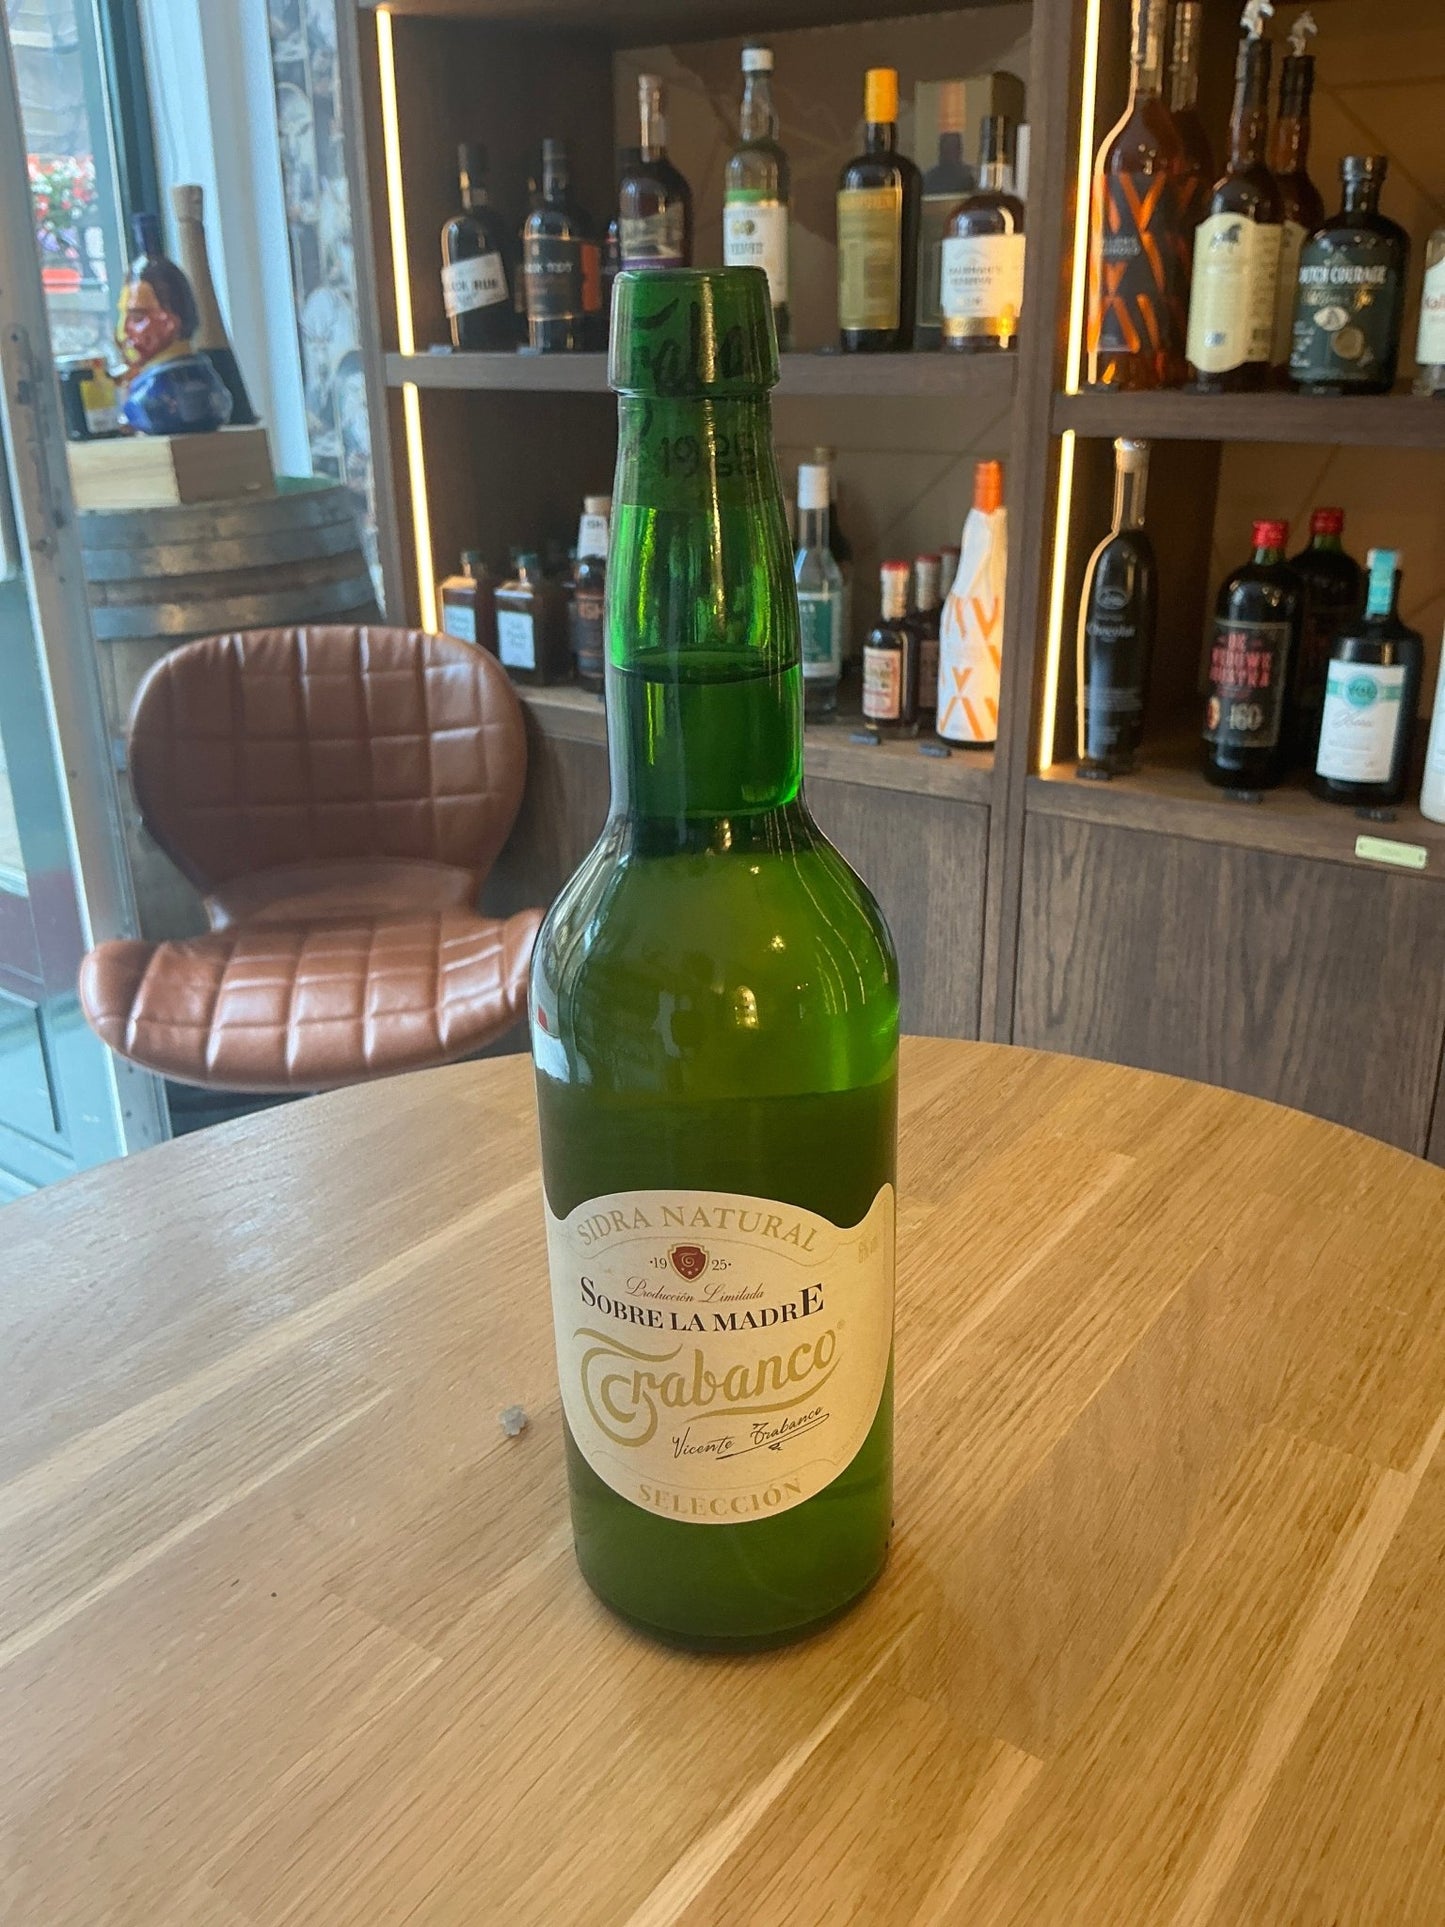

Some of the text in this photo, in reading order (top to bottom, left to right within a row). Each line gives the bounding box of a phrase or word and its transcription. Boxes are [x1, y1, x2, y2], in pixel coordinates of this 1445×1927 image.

[577, 1207, 652, 1246] SIDRA
[661, 1205, 818, 1252] NATURAL
[580, 1276, 824, 1332] SOBRE LA MADRE
[625, 1276, 764, 1303] Producción Limitada
[573, 1328, 837, 1447] Trabanco
[672, 1406, 823, 1459] Vicente Trabanco
[639, 1477, 802, 1517] SELECCIÓN
